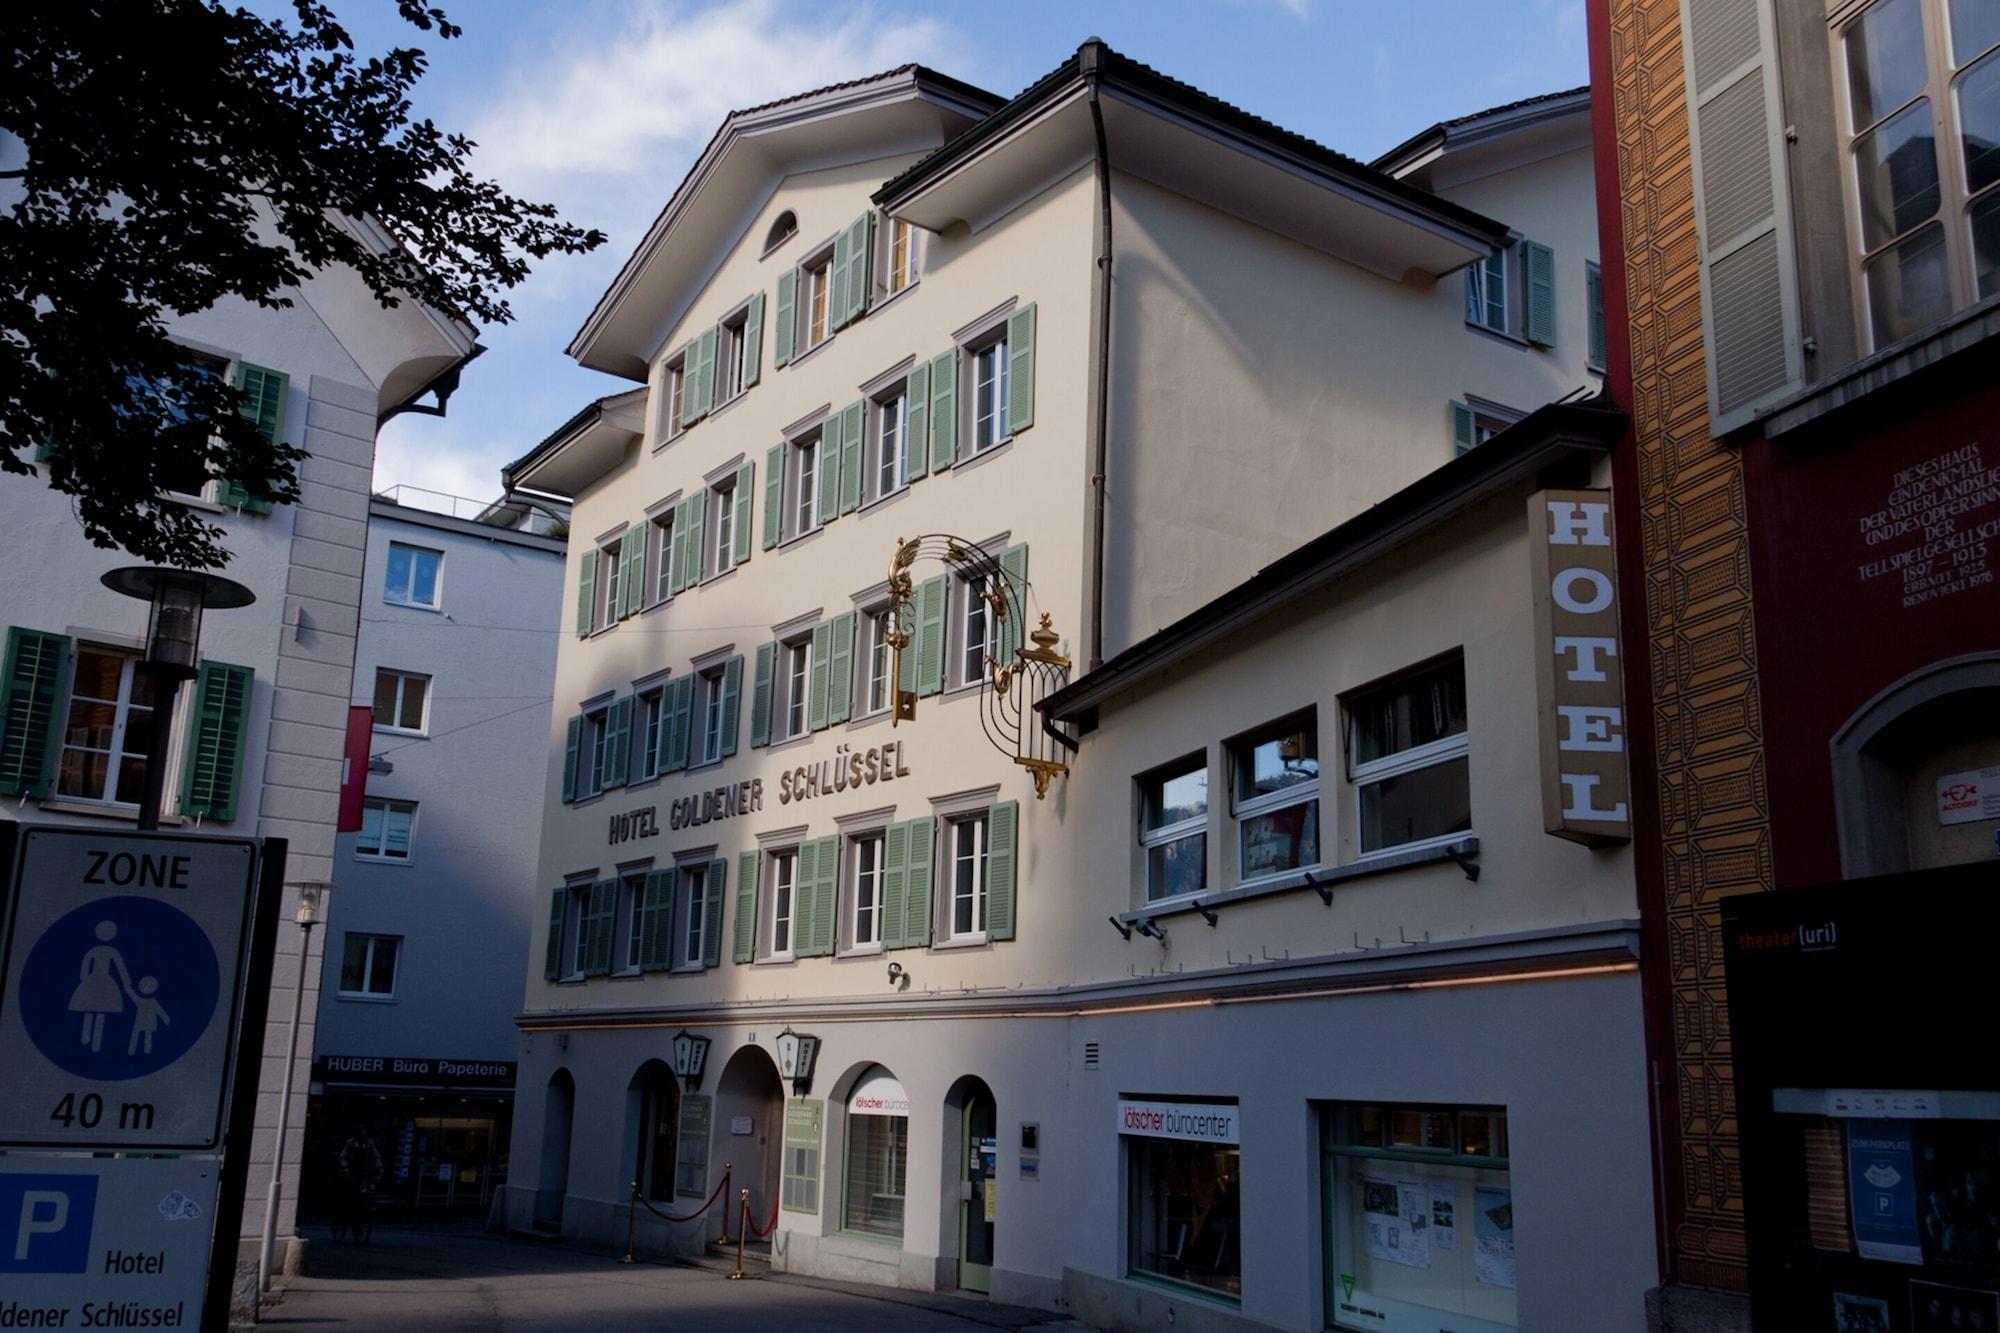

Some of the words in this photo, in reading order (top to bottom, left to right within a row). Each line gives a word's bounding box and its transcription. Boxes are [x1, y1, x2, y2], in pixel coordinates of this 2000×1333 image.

[1893, 457, 1940, 489] DIESES
[1940, 440, 1981, 468] HAUS
[1887, 486, 1912, 506] EIN
[1912, 457, 1986, 495] DENKMAL
[1859, 510, 1888, 534] DER
[1865, 524, 1895, 546] UND
[1894, 516, 1921, 537] DES
[1924, 518, 1956, 542] DER
[1902, 560, 1934, 584] 1897
[1952, 541, 1988, 567] 1913
[1902, 579, 1967, 609] RENOVIERT
[1903, 570, 1953, 595] ERBAUT
[1546, 500, 1629, 822] HOTEL
[608, 804, 660, 846] HOTEL
[670, 777, 764, 832] GOLDENER
[778, 739, 911, 805] SCHLÜSSEL
[83, 850, 192, 889] ZONE
[327, 1056, 385, 1073] HUBER
[392, 1058, 430, 1075] Büro
[437, 1060, 508, 1077] Papeterie
[51, 1092, 103, 1130] 40
[118, 1099, 155, 1130] m
[1124, 1106, 1164, 1132] lötscher
[1166, 1108, 1232, 1137] bürocenter
[14, 1189, 70, 1261] P
[104, 1250, 165, 1275] Hotel
[80, 1300, 183, 1328] Schlüssel
